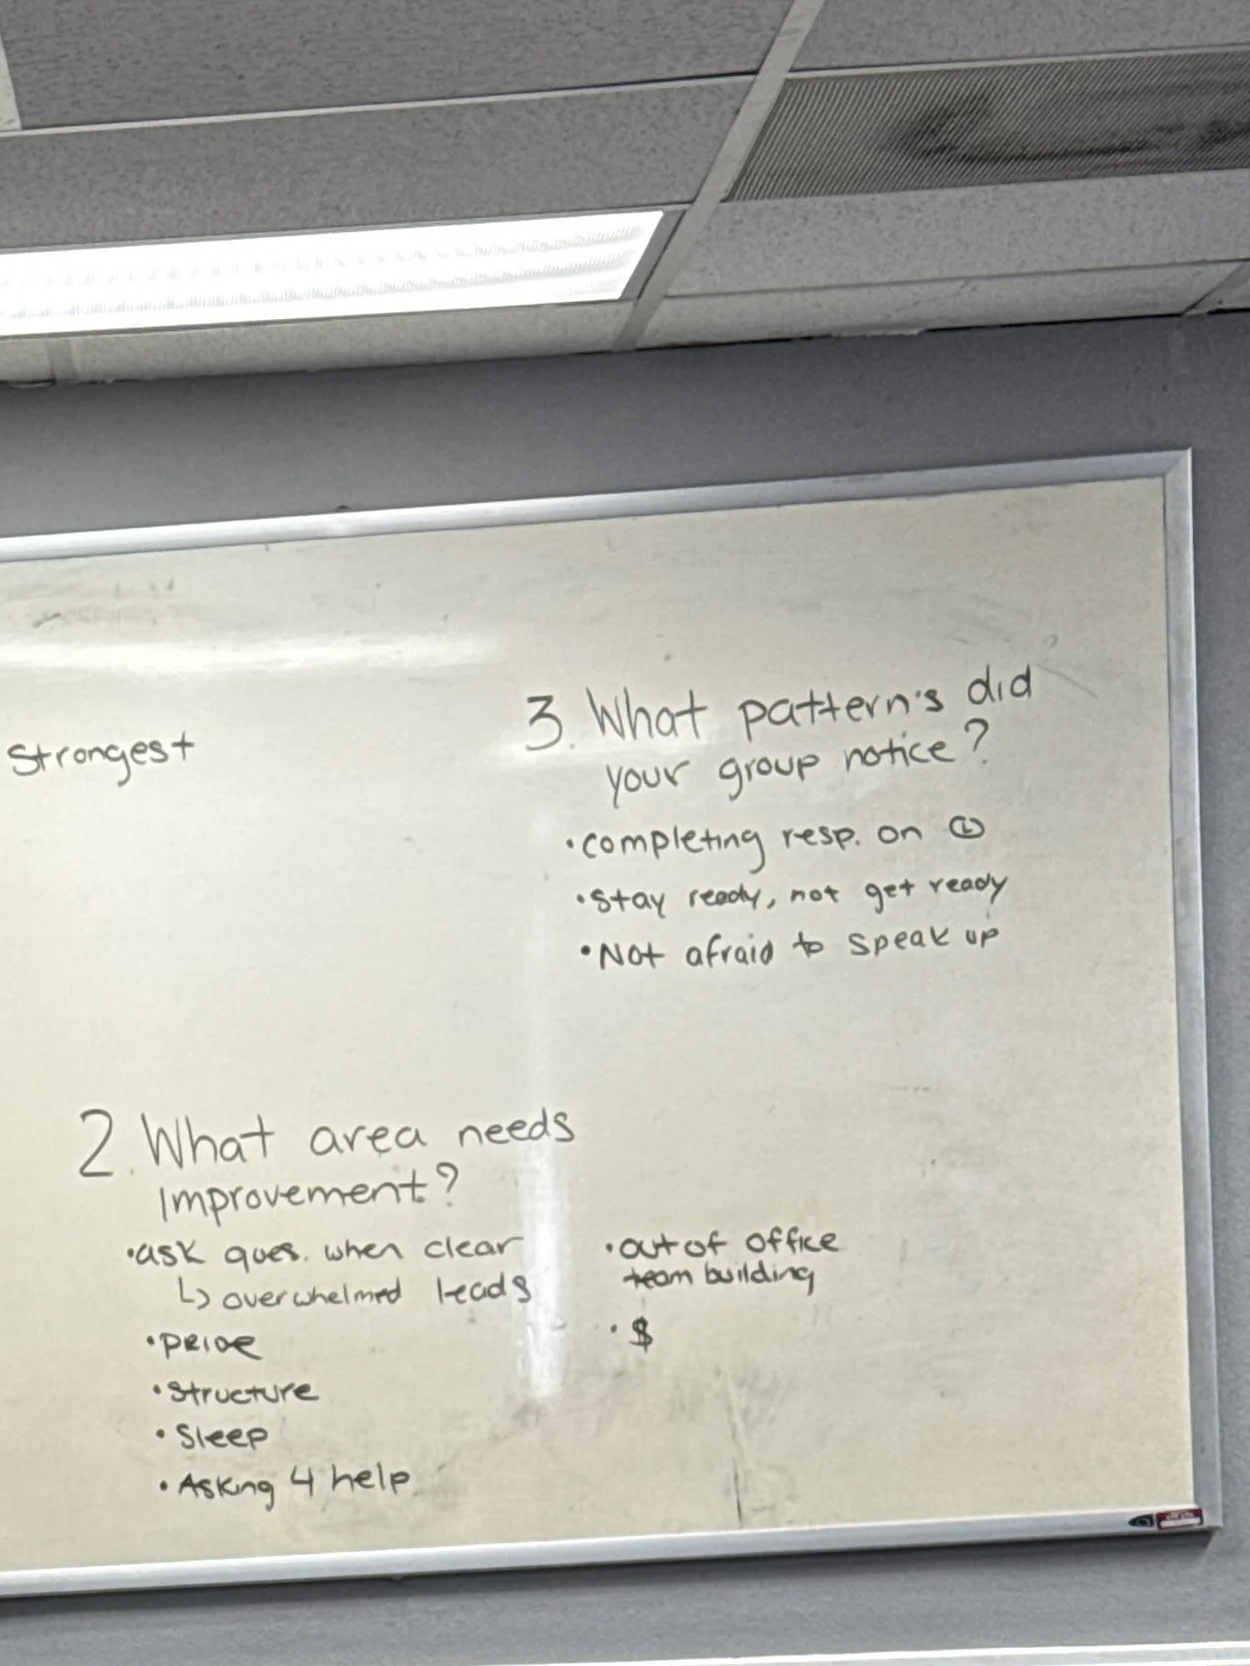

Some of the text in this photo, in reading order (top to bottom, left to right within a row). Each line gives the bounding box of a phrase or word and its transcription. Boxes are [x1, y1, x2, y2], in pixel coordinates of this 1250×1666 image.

[526, 694, 576, 751] 3.
[586, 687, 709, 741] What
[967, 664, 1033, 705] did
[607, 759, 691, 809] your
[719, 752, 820, 801] group
[582, 824, 922, 874] completing resp. on
[689, 884, 776, 911] ready,
[790, 885, 840, 903] not
[864, 878, 915, 914] get
[929, 872, 1009, 905] ready
[600, 942, 666, 969] Not
[685, 933, 774, 968] afraid
[792, 931, 825, 958] to
[965, 927, 1000, 949] up
[79, 1106, 576, 1178] 2. What area needs
[135, 1240, 205, 1267] ask
[324, 1239, 404, 1261] when
[424, 1235, 524, 1260] clear
[437, 1272, 532, 1304] leads
[704, 1260, 815, 1296] building
[628, 1316, 654, 1354] $
[178, 1461, 411, 1512] Asking 4 help
